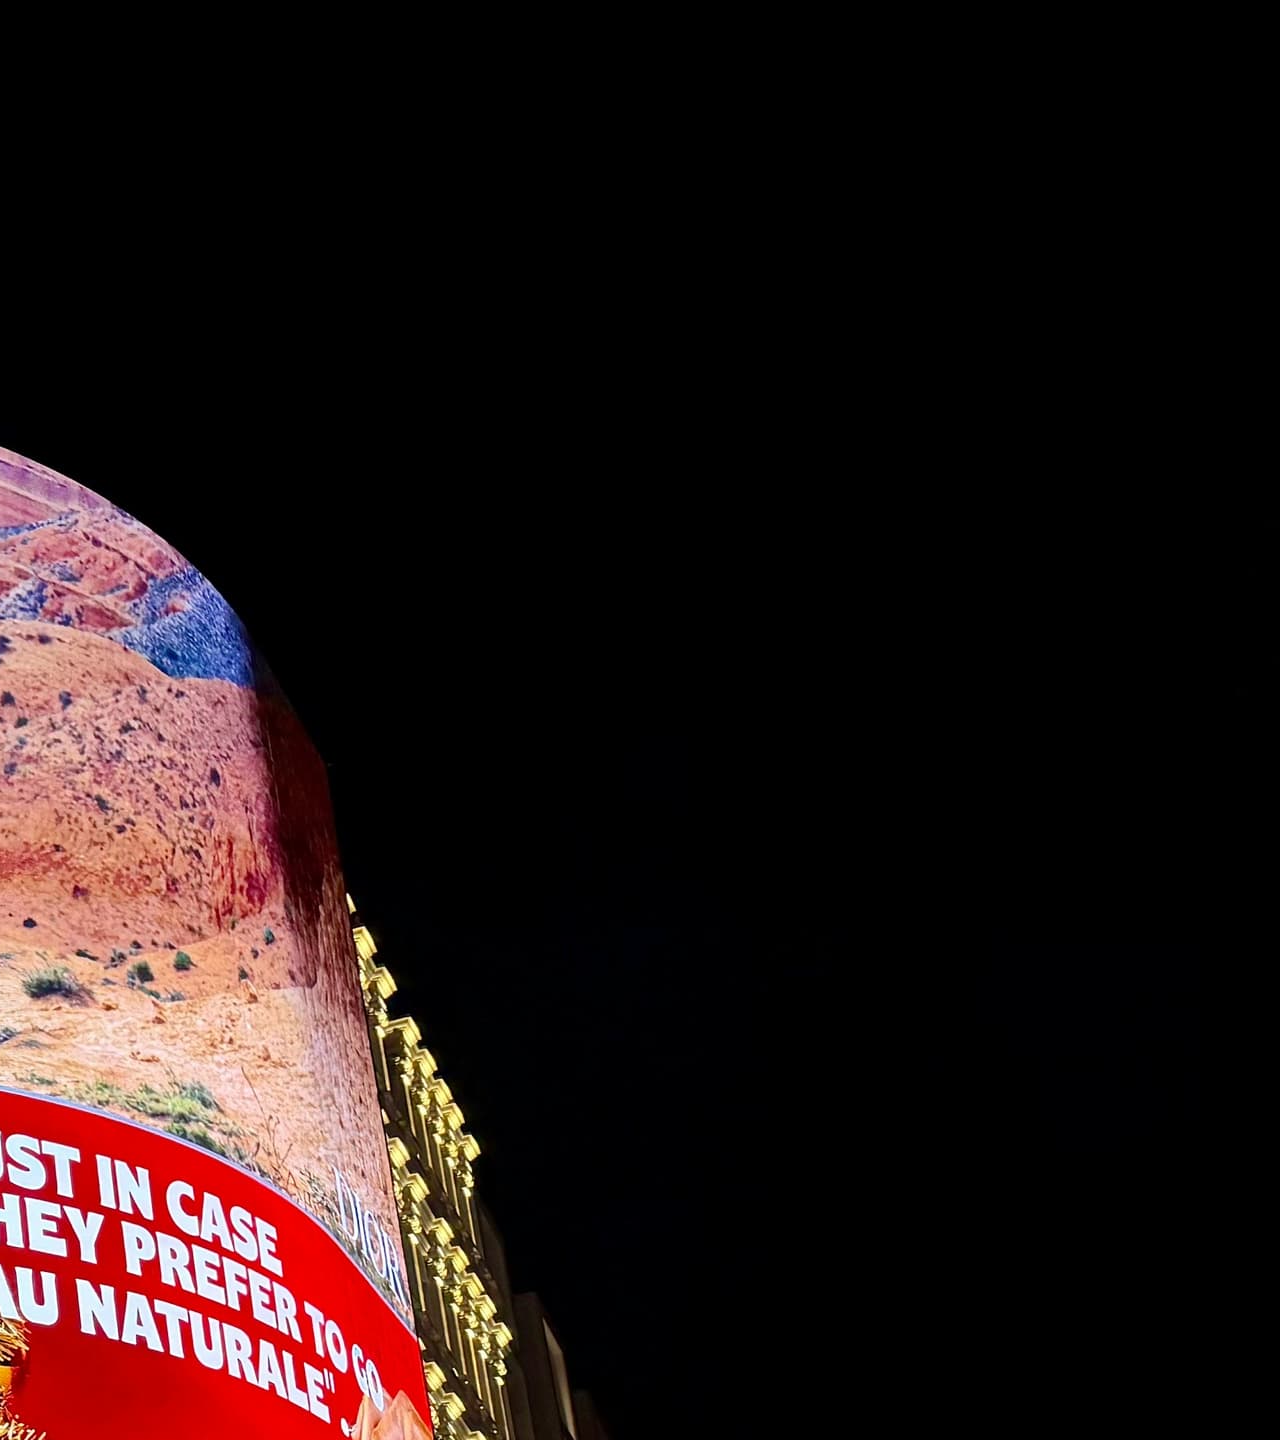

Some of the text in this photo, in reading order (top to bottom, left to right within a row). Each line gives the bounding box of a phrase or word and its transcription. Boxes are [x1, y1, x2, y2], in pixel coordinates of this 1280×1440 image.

[95, 1153, 154, 1221] IN
[165, 1178, 283, 1278] CASE
[331, 1164, 410, 1312] DIOR
[121, 1220, 303, 1343] PREFER
[304, 1301, 350, 1373] TO
[352, 1344, 385, 1413] GO
